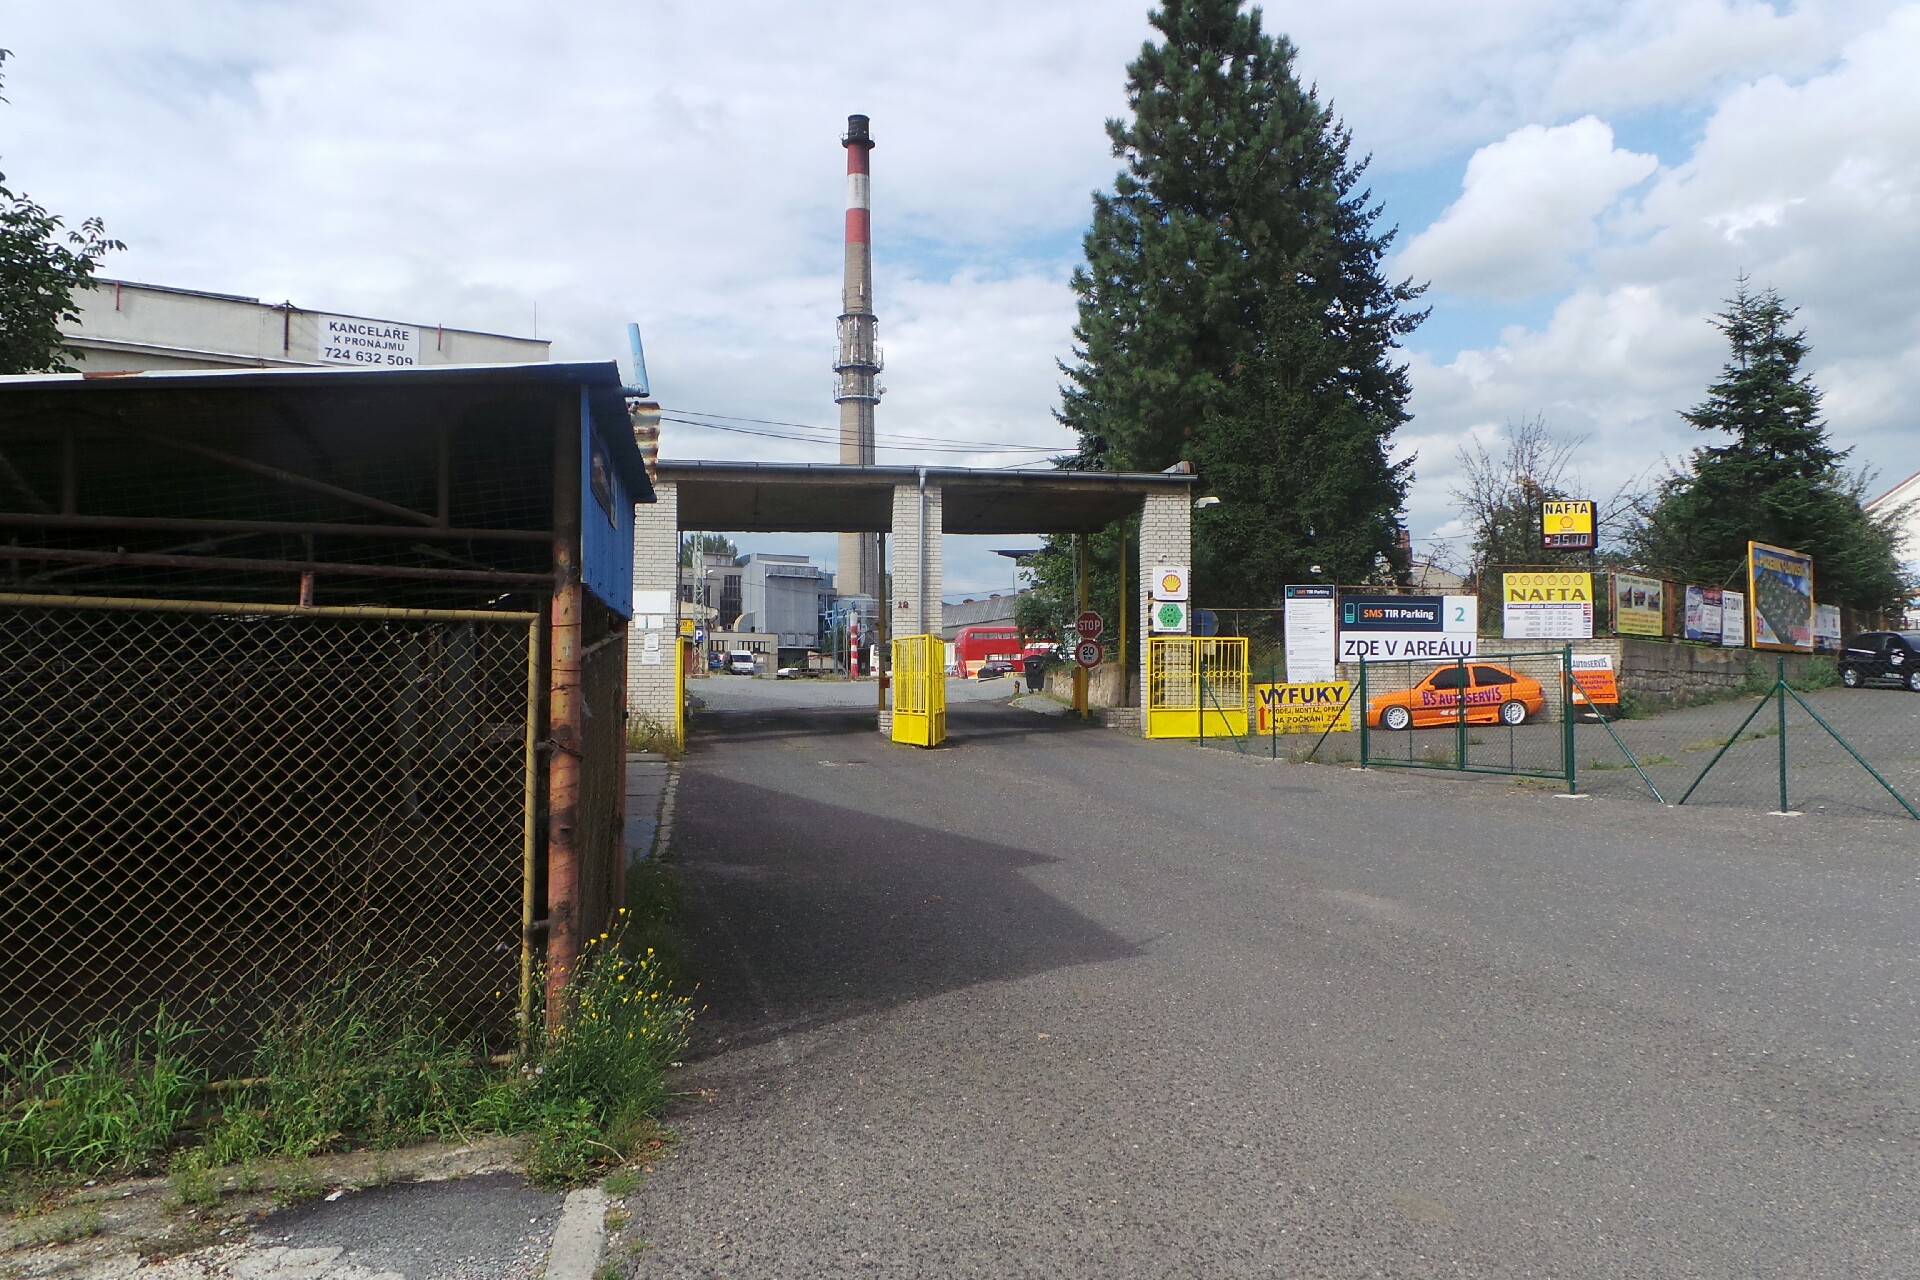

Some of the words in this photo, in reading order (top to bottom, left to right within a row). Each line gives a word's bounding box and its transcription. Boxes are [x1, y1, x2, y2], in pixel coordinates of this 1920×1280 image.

[330, 321, 410, 341] KANCELÁŘE
[334, 335, 341, 344] K
[345, 336, 405, 352] PRONÁJMU
[324, 347, 350, 360] 724
[356, 351, 382, 364] 632
[388, 355, 413, 366] 509
[1546, 503, 1588, 514] NAFTA
[1510, 588, 1586, 602] NAFTA
[1364, 609, 1383, 618] SMS
[1384, 610, 1399, 618] TIR
[1401, 610, 1434, 620] Parking
[1455, 607, 1465, 622] 2
[1080, 621, 1100, 630] STOP
[696, 630, 703, 640] P
[1083, 647, 1094, 655] 20
[1345, 640, 1379, 656] ZDE
[1385, 640, 1398, 655] V
[1404, 637, 1472, 656] AREÁLU
[1573, 658, 1607, 667] AUTOSERVIS
[1260, 685, 1344, 704] VÝFUKY
[1422, 690, 1436, 706] BS
